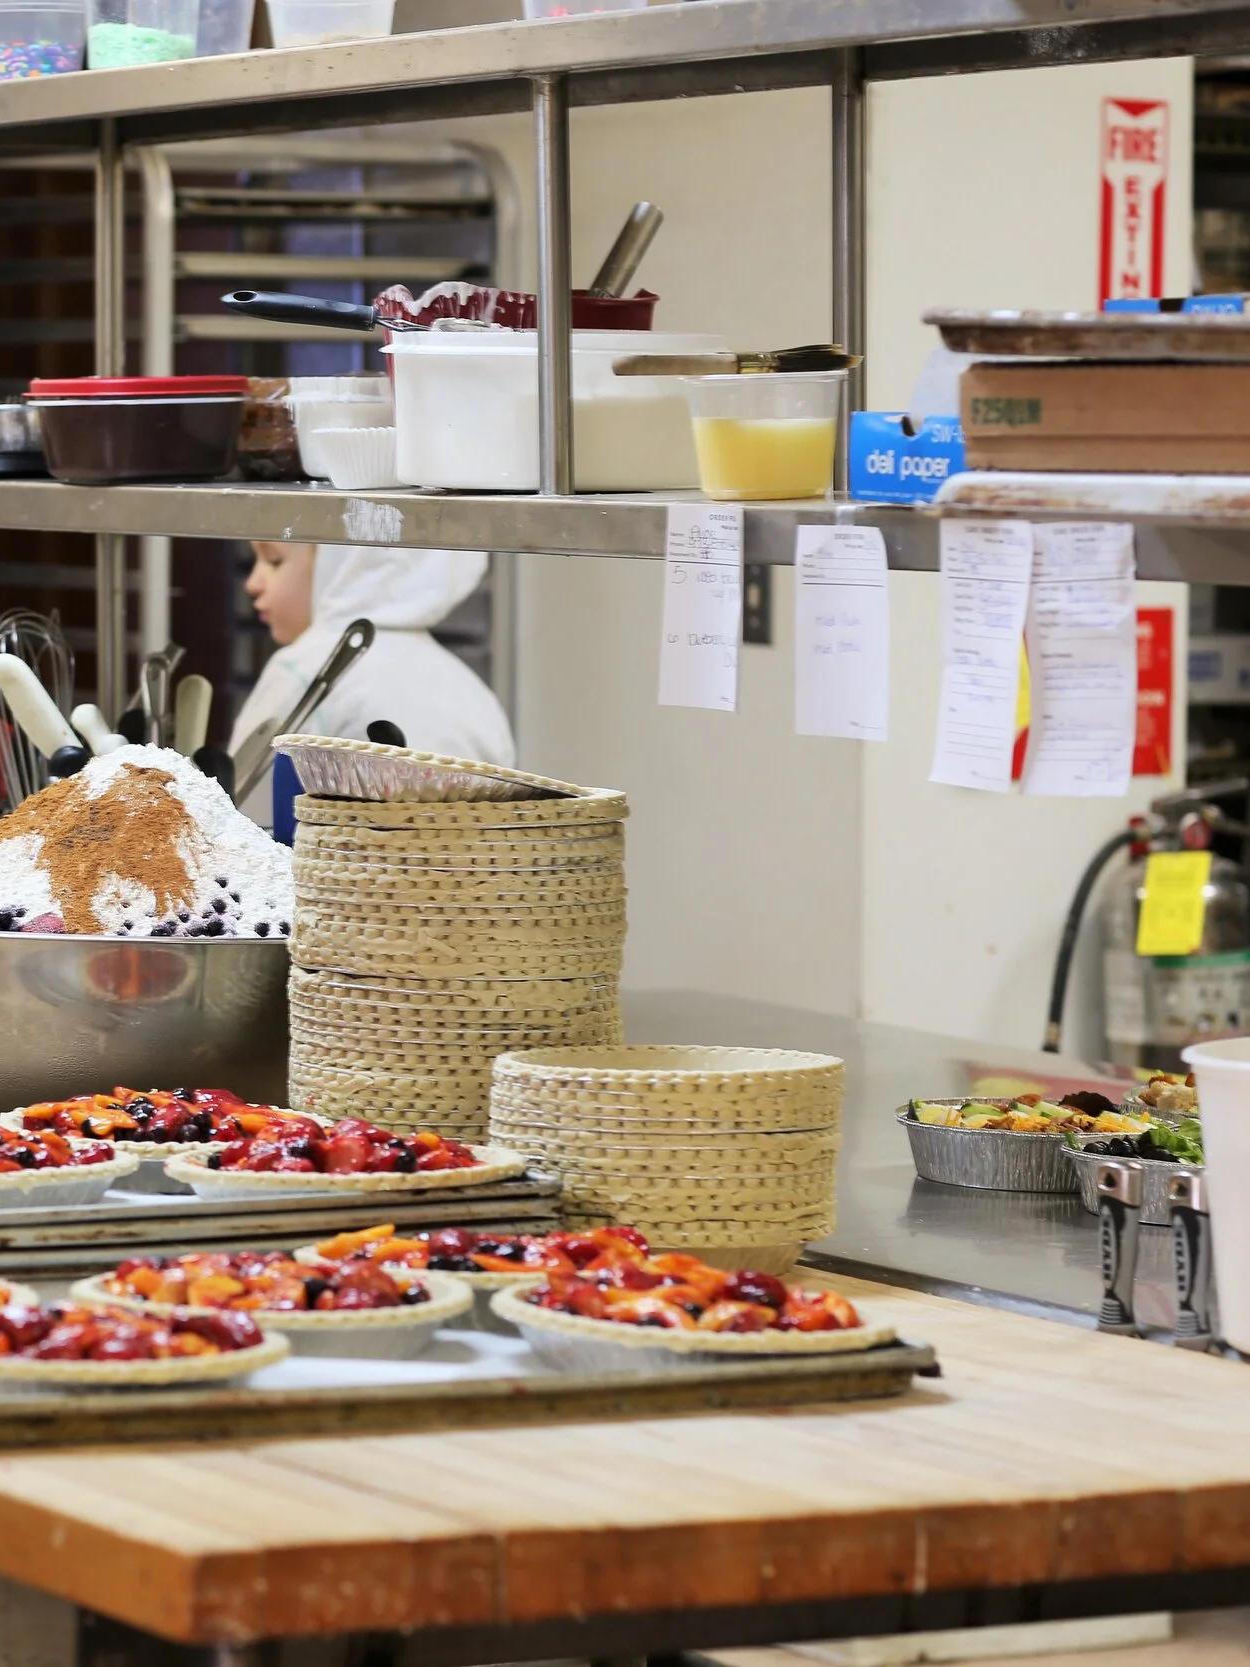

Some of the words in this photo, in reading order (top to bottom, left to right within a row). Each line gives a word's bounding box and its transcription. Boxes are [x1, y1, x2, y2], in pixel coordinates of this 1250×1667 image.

[1109, 126, 1158, 163] FIRE
[866, 449, 895, 474] deli
[900, 456, 950, 481] paper
